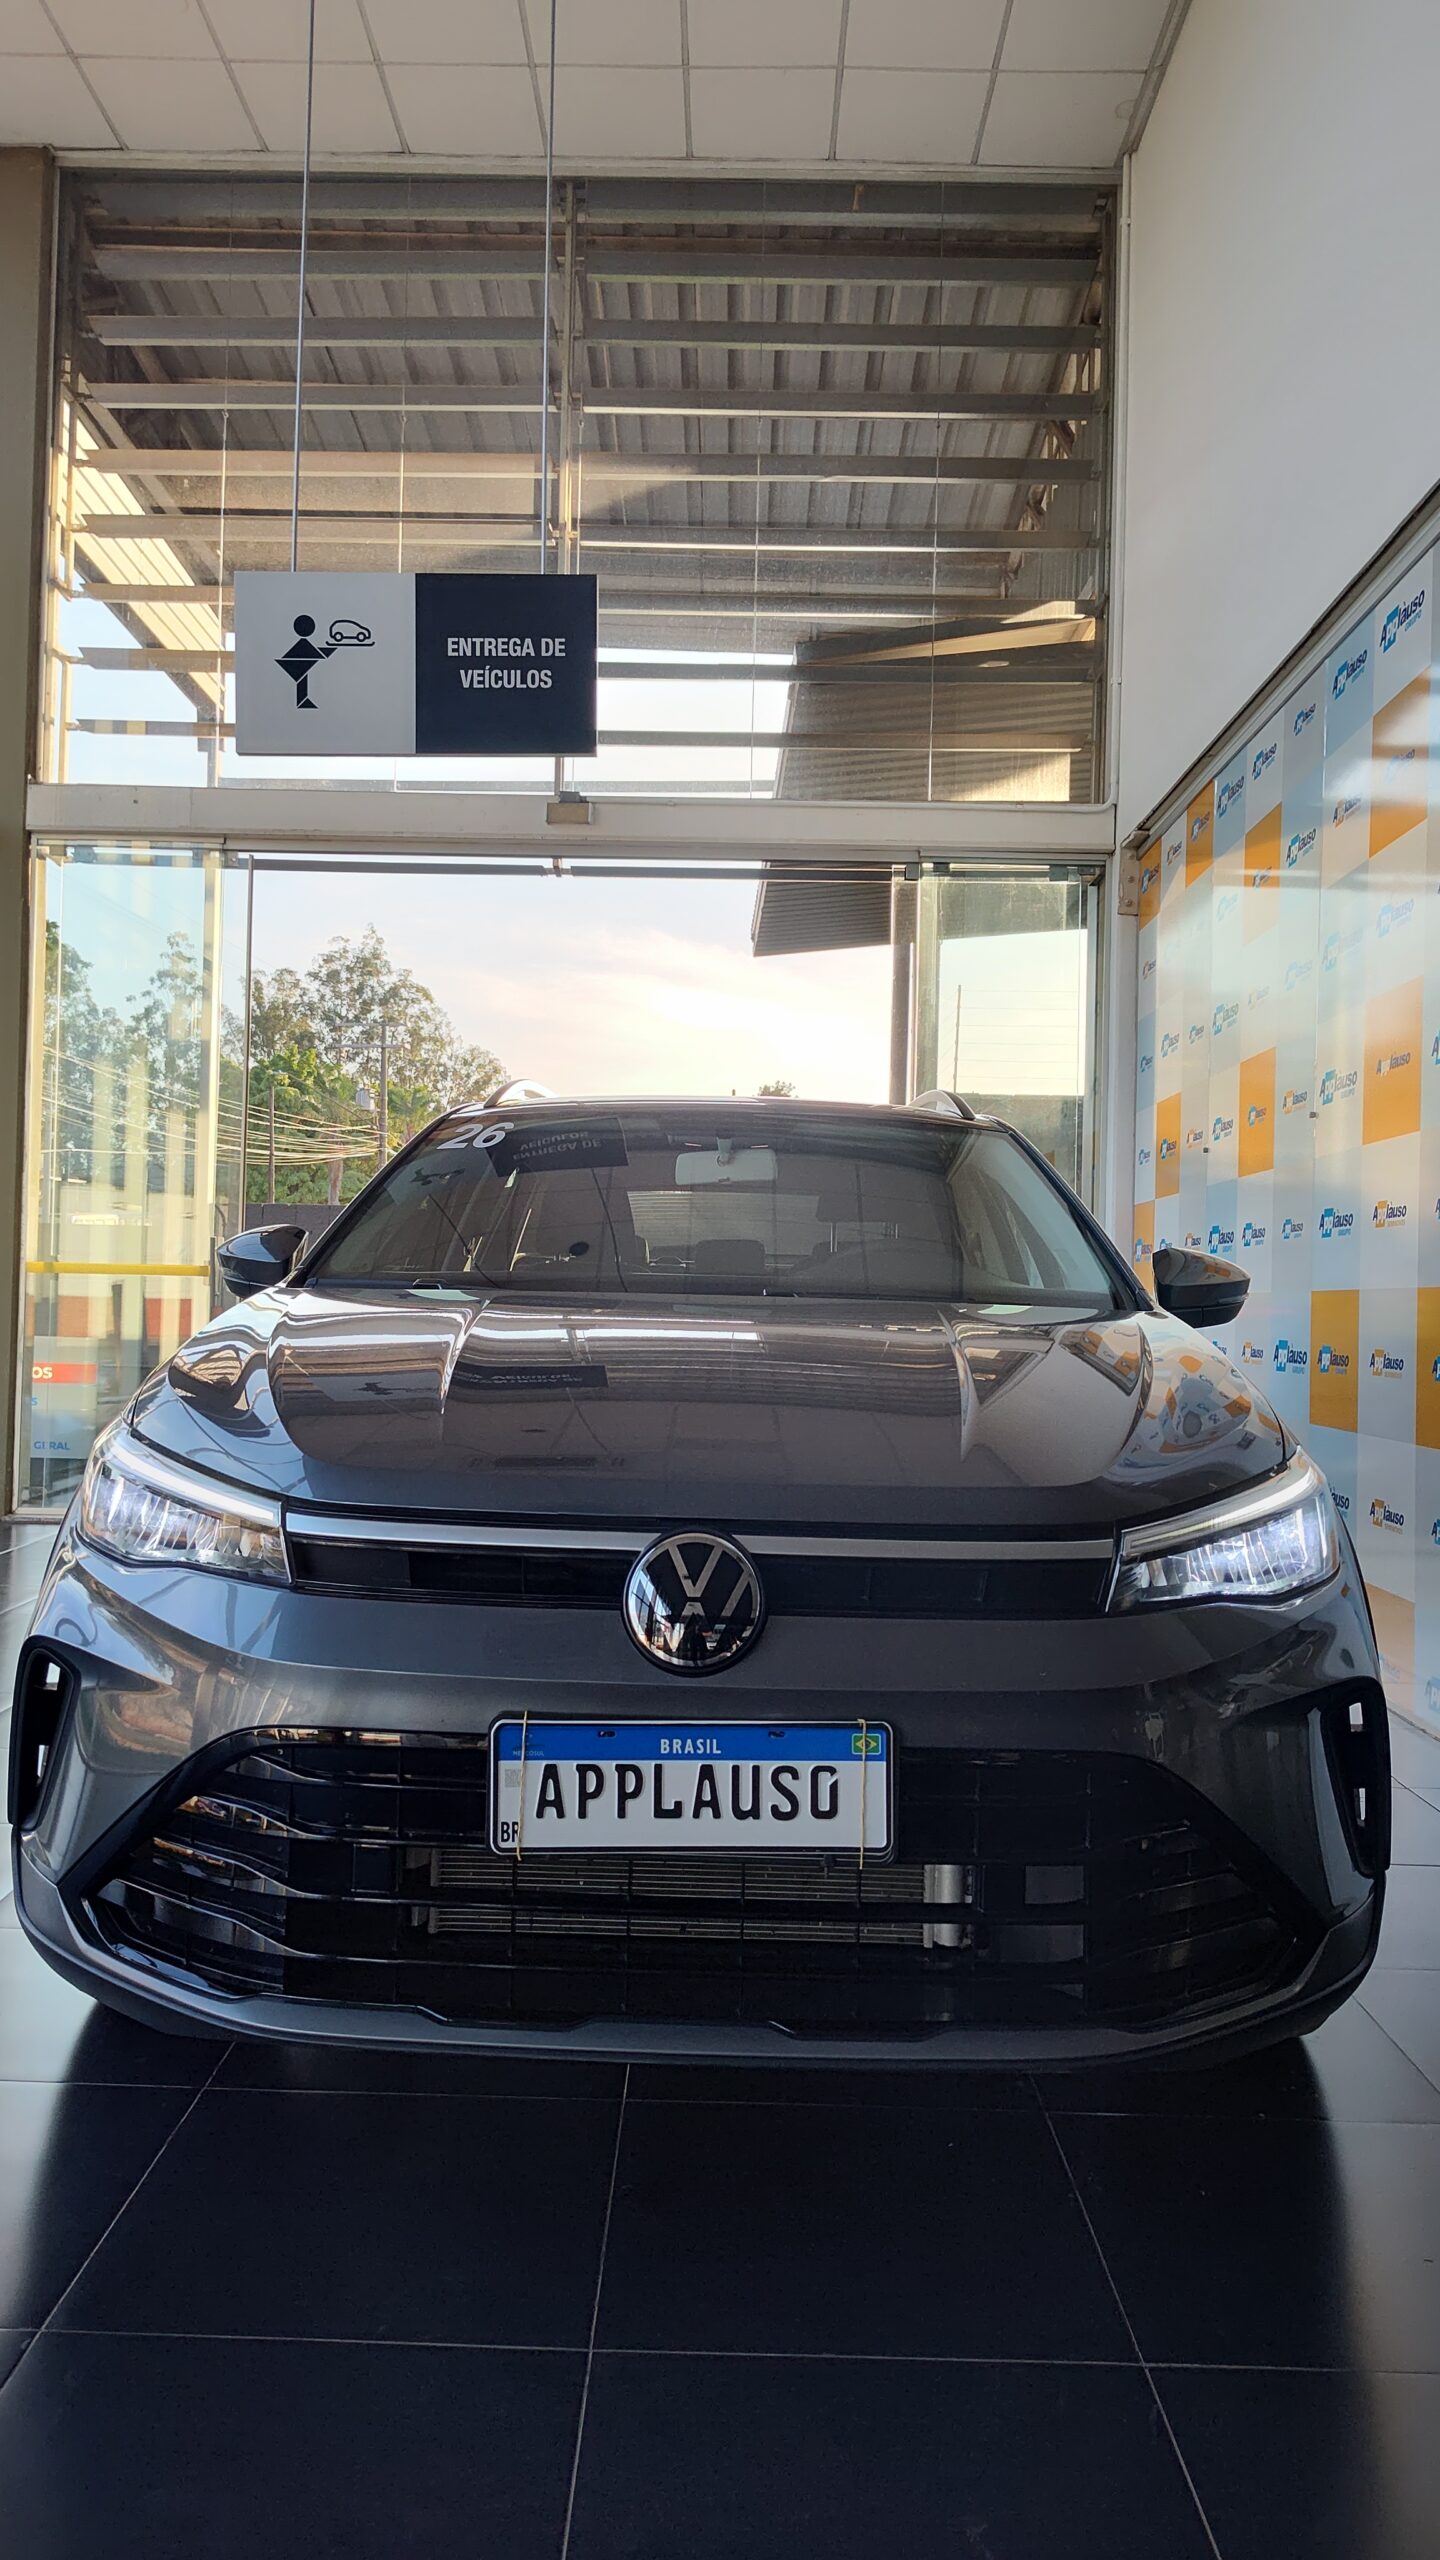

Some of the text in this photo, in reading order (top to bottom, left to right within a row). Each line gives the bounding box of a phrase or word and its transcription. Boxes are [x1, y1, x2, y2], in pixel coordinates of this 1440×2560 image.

[447, 638, 566, 656] ENTREGA DE
[460, 665, 552, 689] VEÍCULOS
[436, 1122, 515, 1149] 26
[660, 1739, 721, 1754] BRASIL
